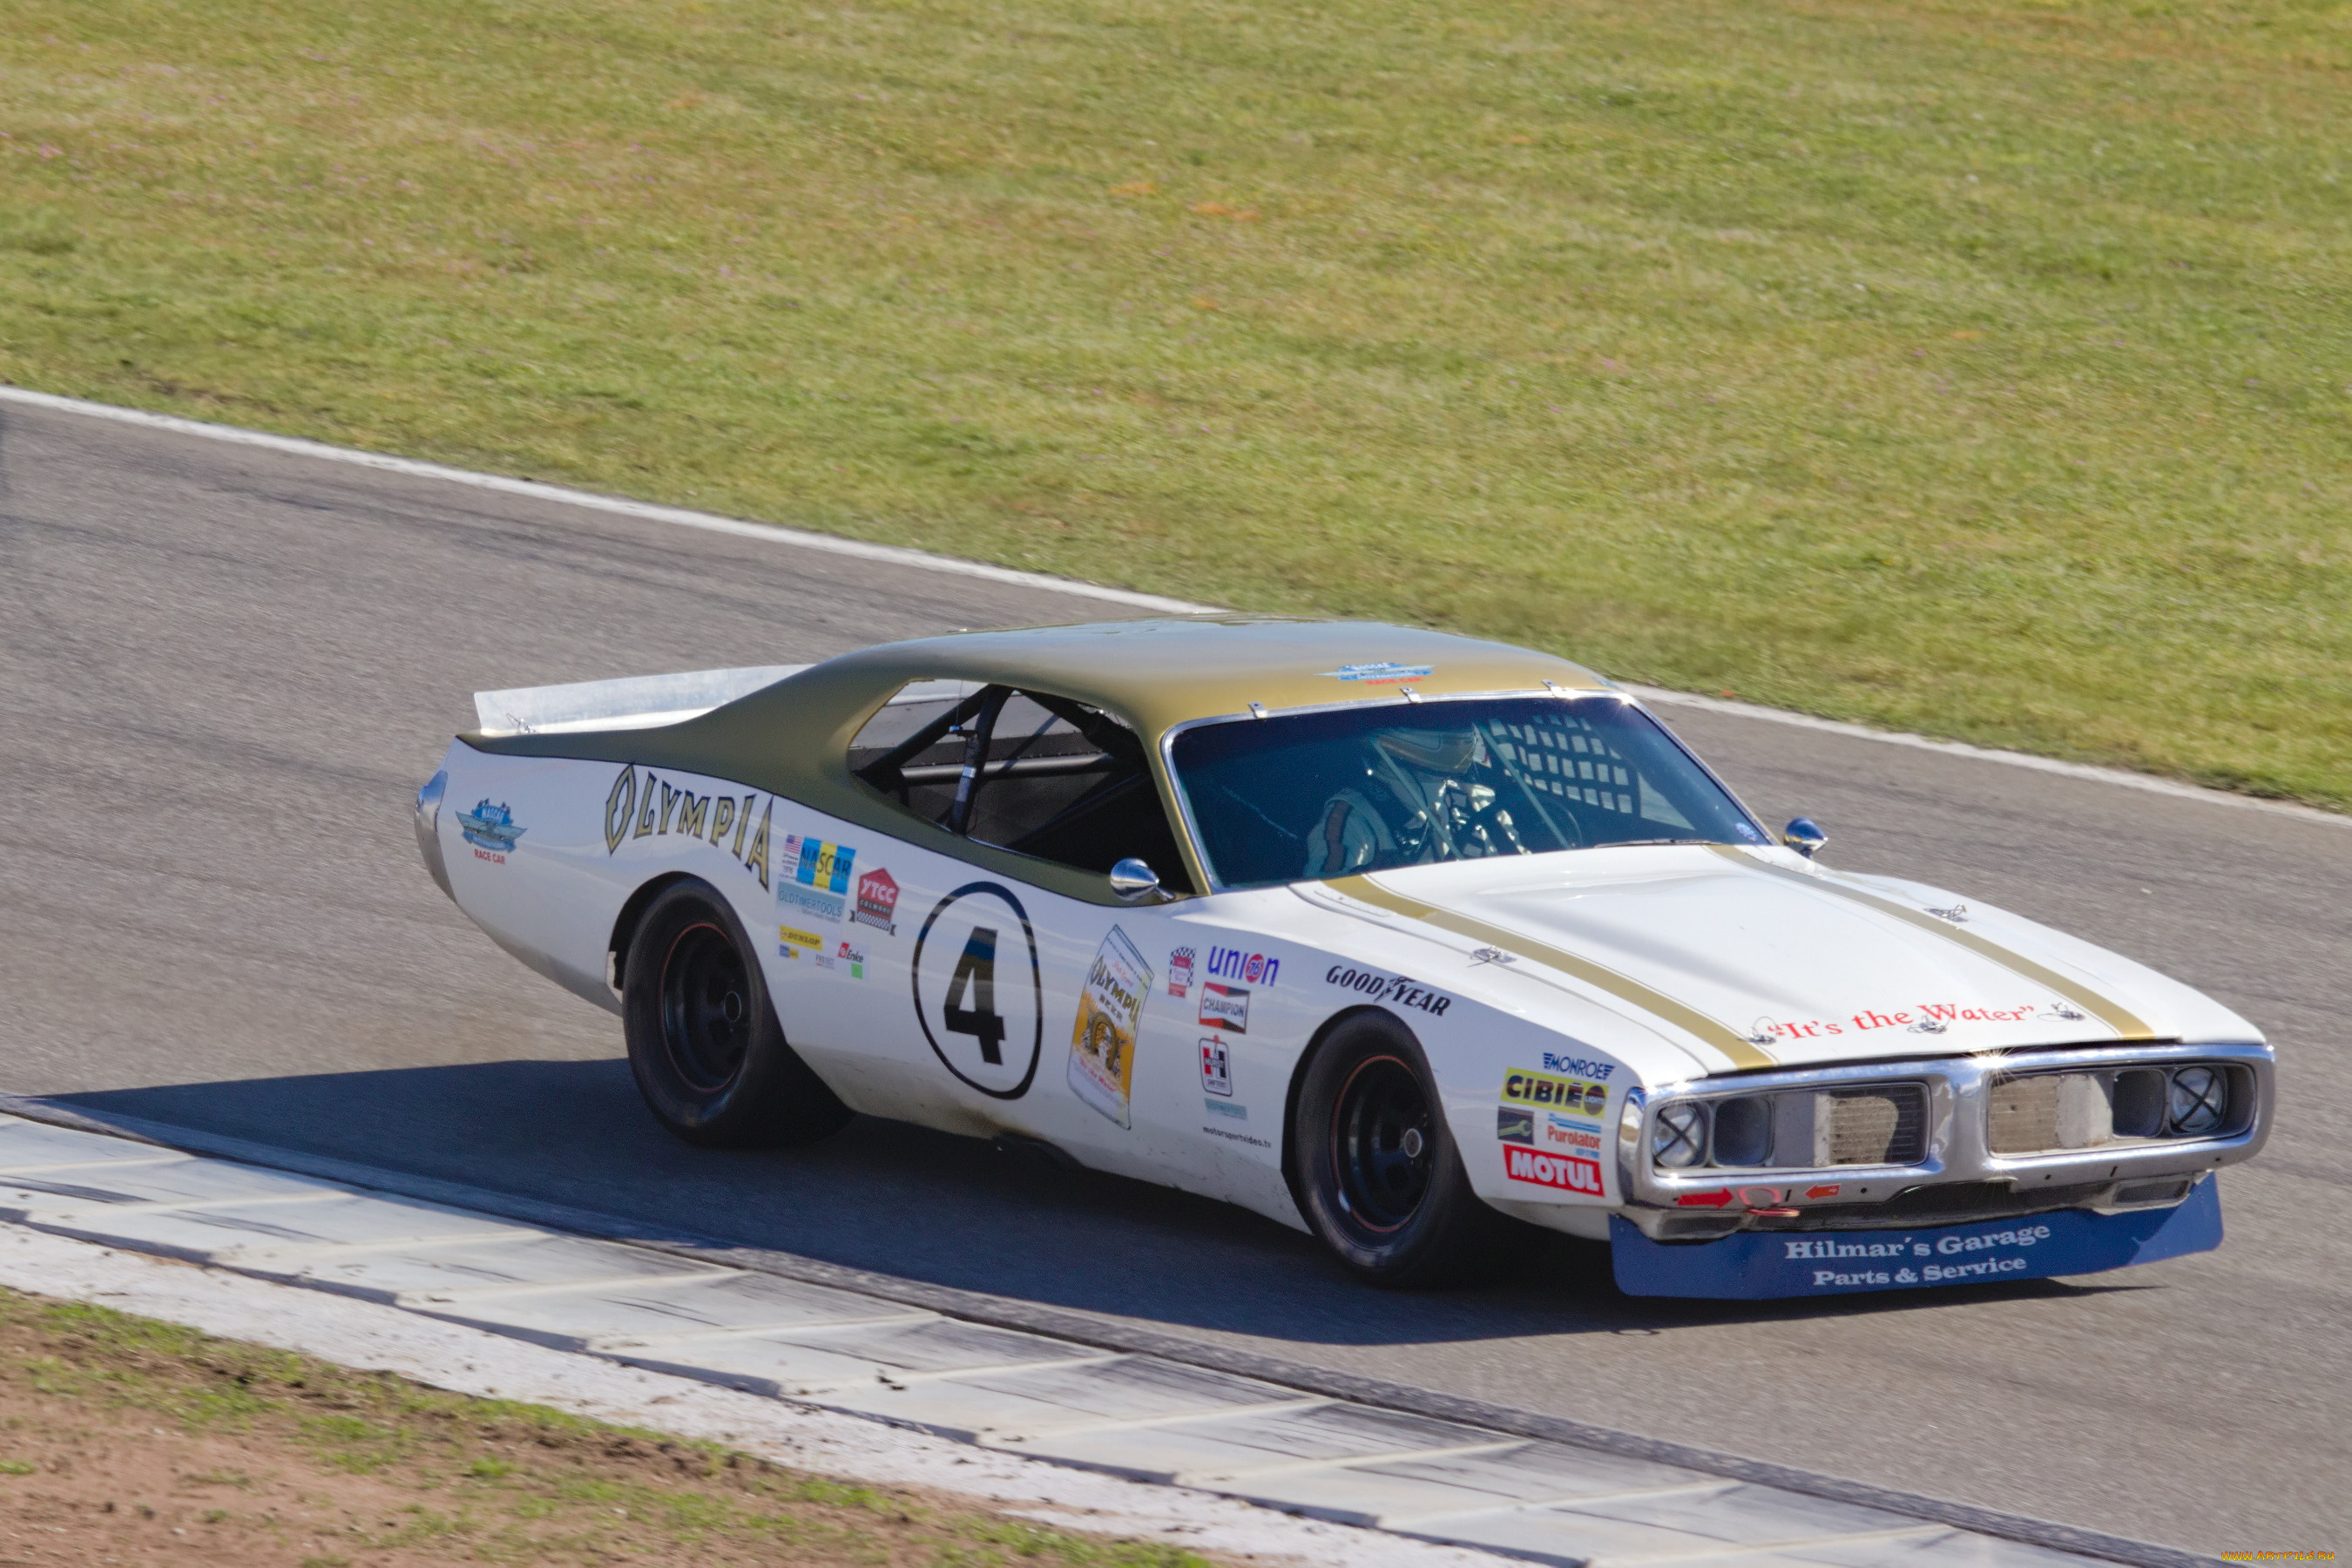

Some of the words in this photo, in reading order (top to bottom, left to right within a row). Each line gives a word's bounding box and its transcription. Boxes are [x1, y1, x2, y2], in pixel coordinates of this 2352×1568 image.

[605, 762, 774, 892] OLYMPIA
[475, 848, 491, 862] RACE
[492, 853, 505, 864] CAR
[799, 847, 852, 880] NASCAR
[779, 889, 842, 917] OLDTIMERTOOLS
[860, 879, 897, 903] YTCC
[787, 932, 821, 946] DUNLOP
[846, 950, 863, 963] Enke
[943, 926, 1006, 1065] 4
[1203, 997, 1245, 1017] CHAMPION
[1851, 1010, 1914, 1031] the
[1550, 1056, 1605, 1079] MONROE
[1547, 1125, 1601, 1150] Purolator
[1511, 1149, 1599, 1193] MOTUL
[1936, 1225, 2051, 1254] Garage
[1813, 1269, 1890, 1287] Parts
[1895, 1267, 1919, 1284] &
[1923, 1256, 2027, 1281] Service
